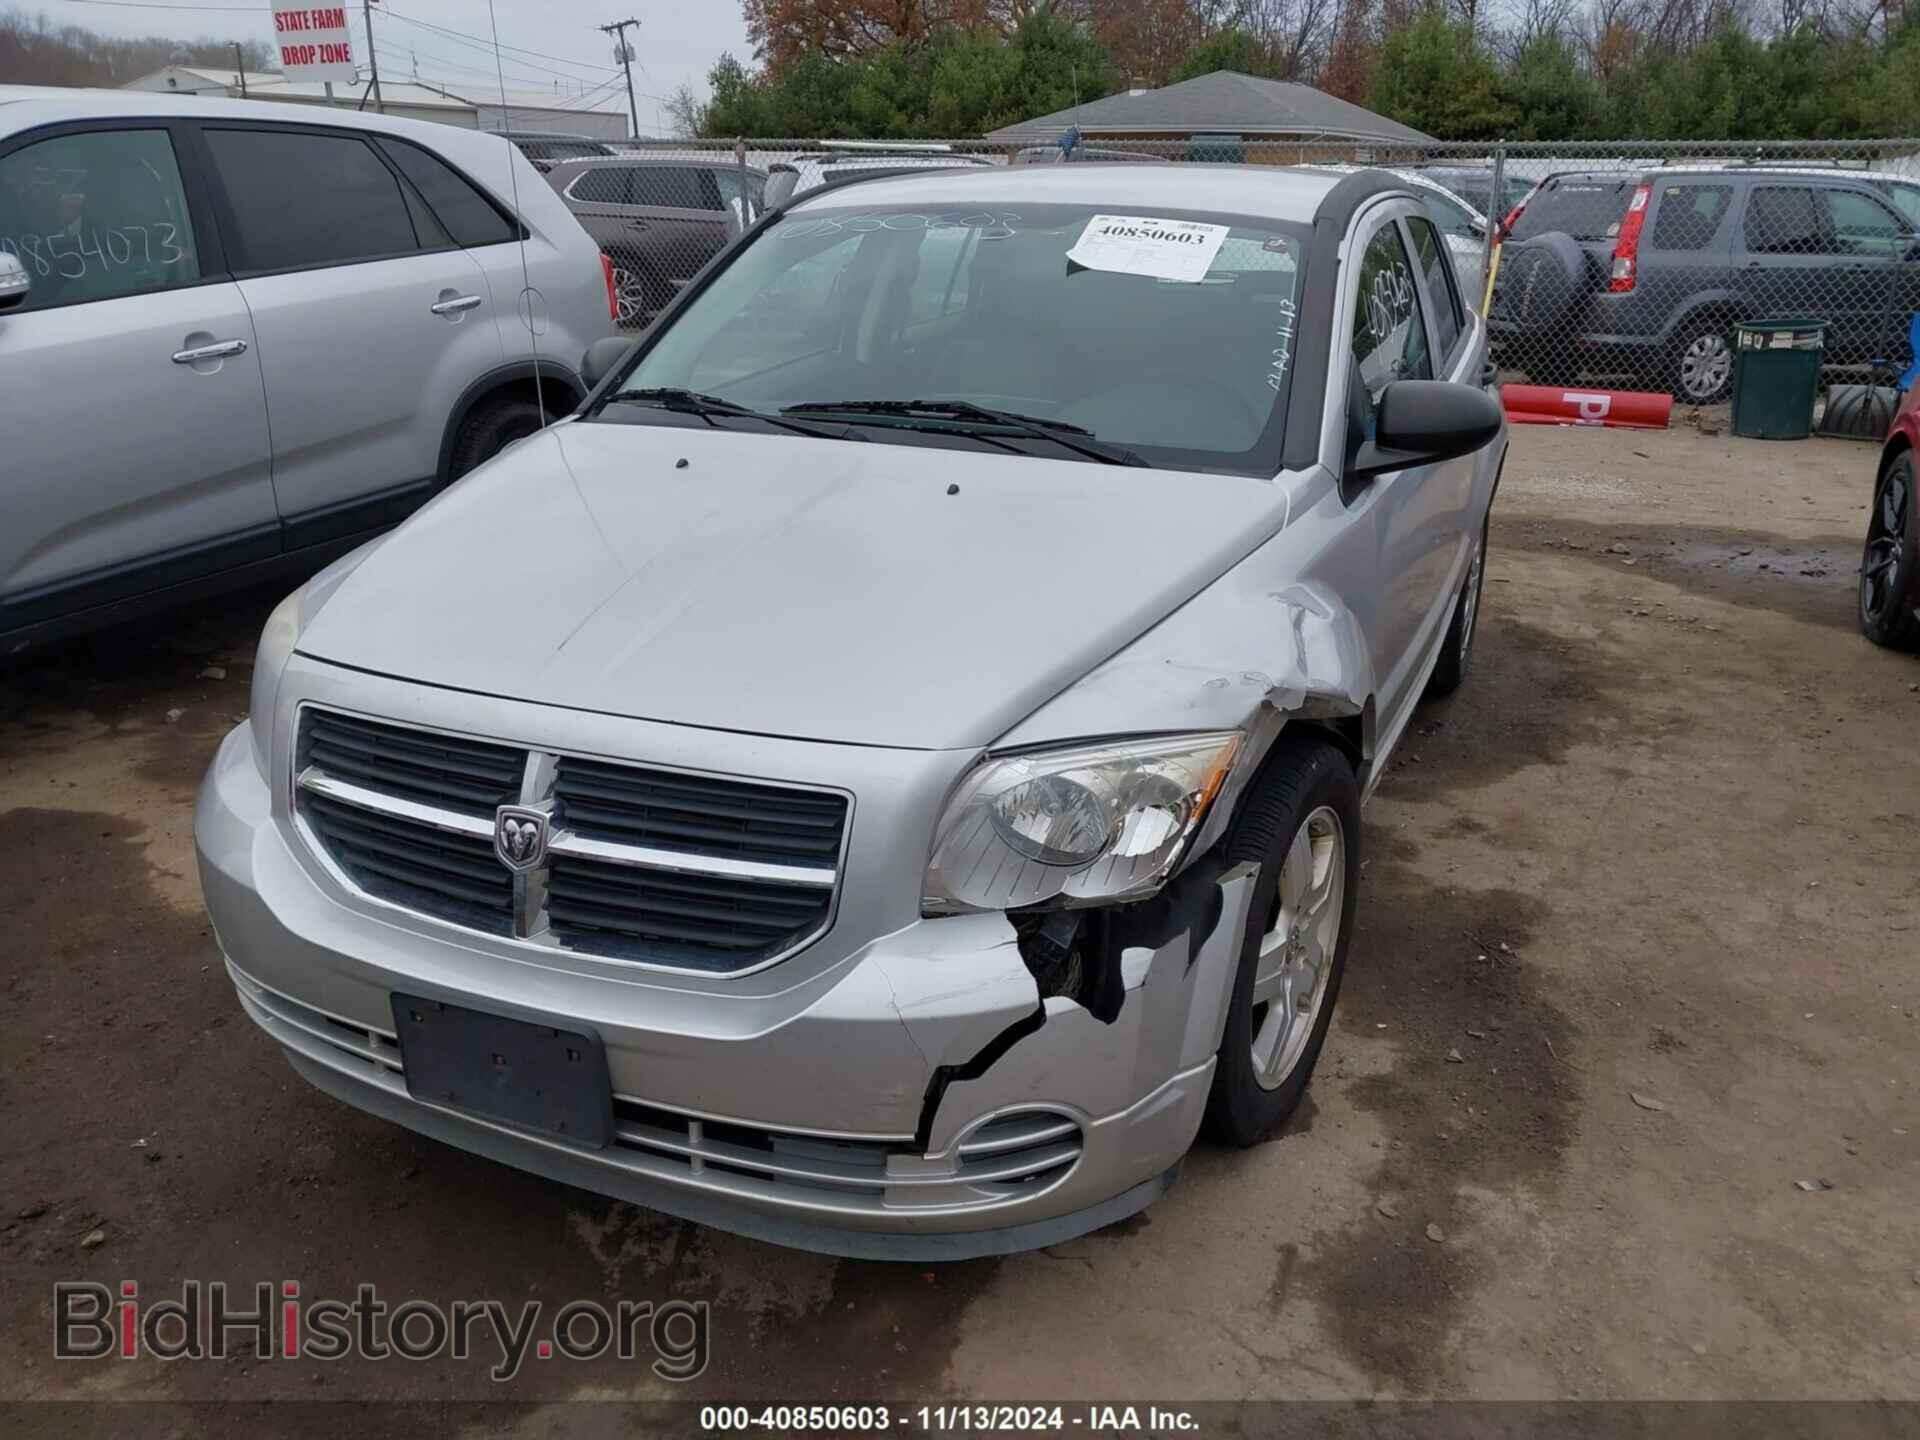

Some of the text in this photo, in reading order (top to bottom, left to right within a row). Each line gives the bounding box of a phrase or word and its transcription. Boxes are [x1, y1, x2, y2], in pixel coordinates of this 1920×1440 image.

[274, 8, 345, 32] STATE FARM
[281, 43, 351, 65] DROP ZONE
[1098, 224, 1206, 246] 40850603
